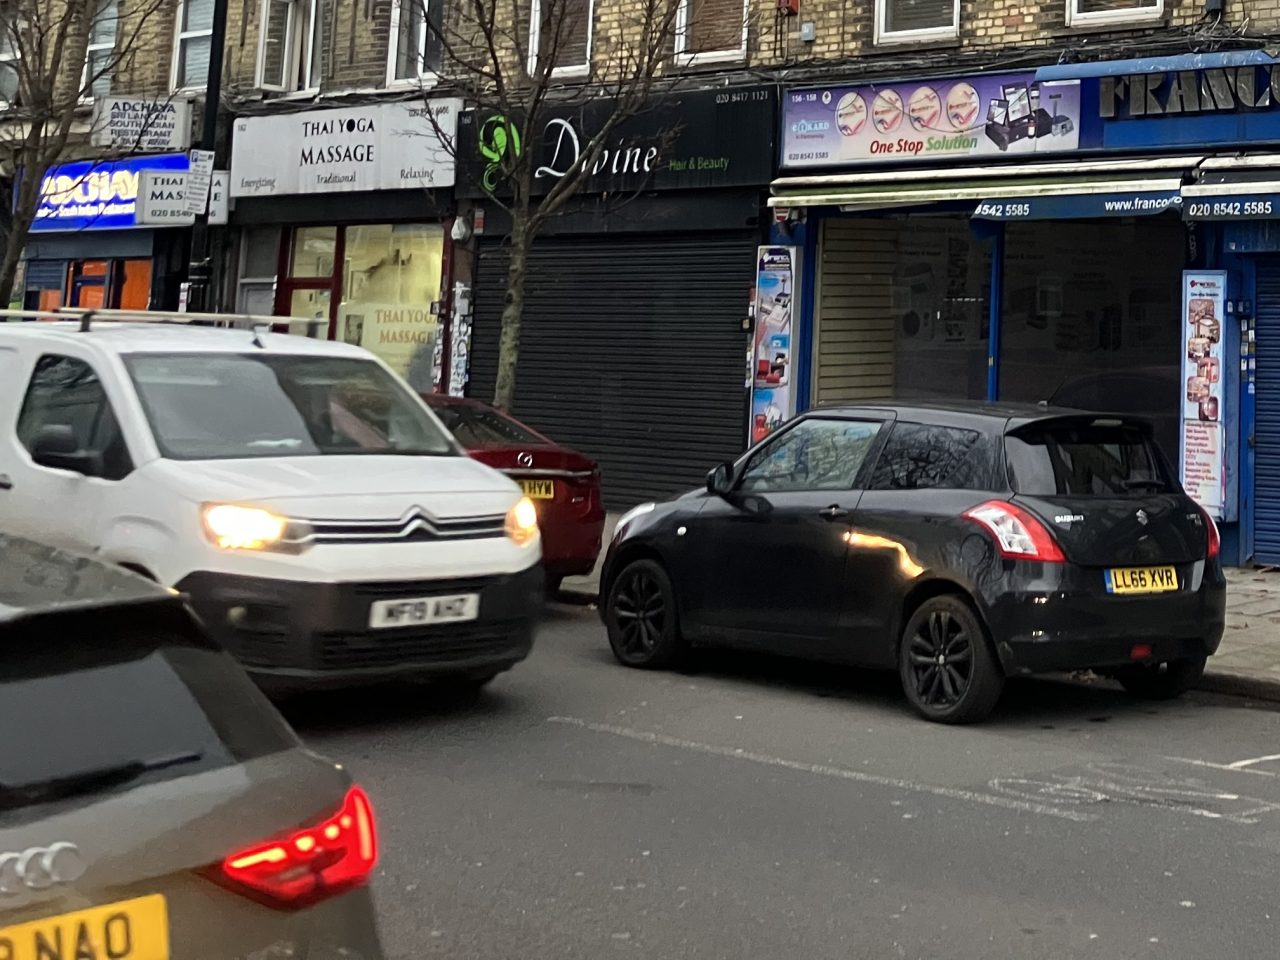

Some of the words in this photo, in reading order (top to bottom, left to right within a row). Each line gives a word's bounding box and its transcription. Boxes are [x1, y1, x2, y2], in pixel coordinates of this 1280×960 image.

[715, 94, 730, 104] 020
[111, 128, 172, 138] RESTARANT
[302, 120, 336, 138] THAI
[338, 117, 375, 134] YOGA
[870, 140, 894, 155] One
[895, 138, 924, 156] Stop
[925, 134, 978, 152] Solution
[299, 144, 375, 167] MASSAGE
[669, 158, 688, 171] Hair
[688, 157, 696, 171] &
[697, 155, 729, 172] Beauty
[151, 176, 184, 186] THAI
[400, 166, 435, 182] Relaxing
[1005, 203, 1030, 216] 5585
[1189, 203, 1210, 216] 020
[1213, 202, 1241, 215] 8542
[1243, 201, 1272, 214] 5585
[374, 309, 405, 325] THAI
[379, 329, 432, 344] MASSAGE
[1113, 570, 1146, 589] LL66
[1150, 569, 1174, 587] XVR
